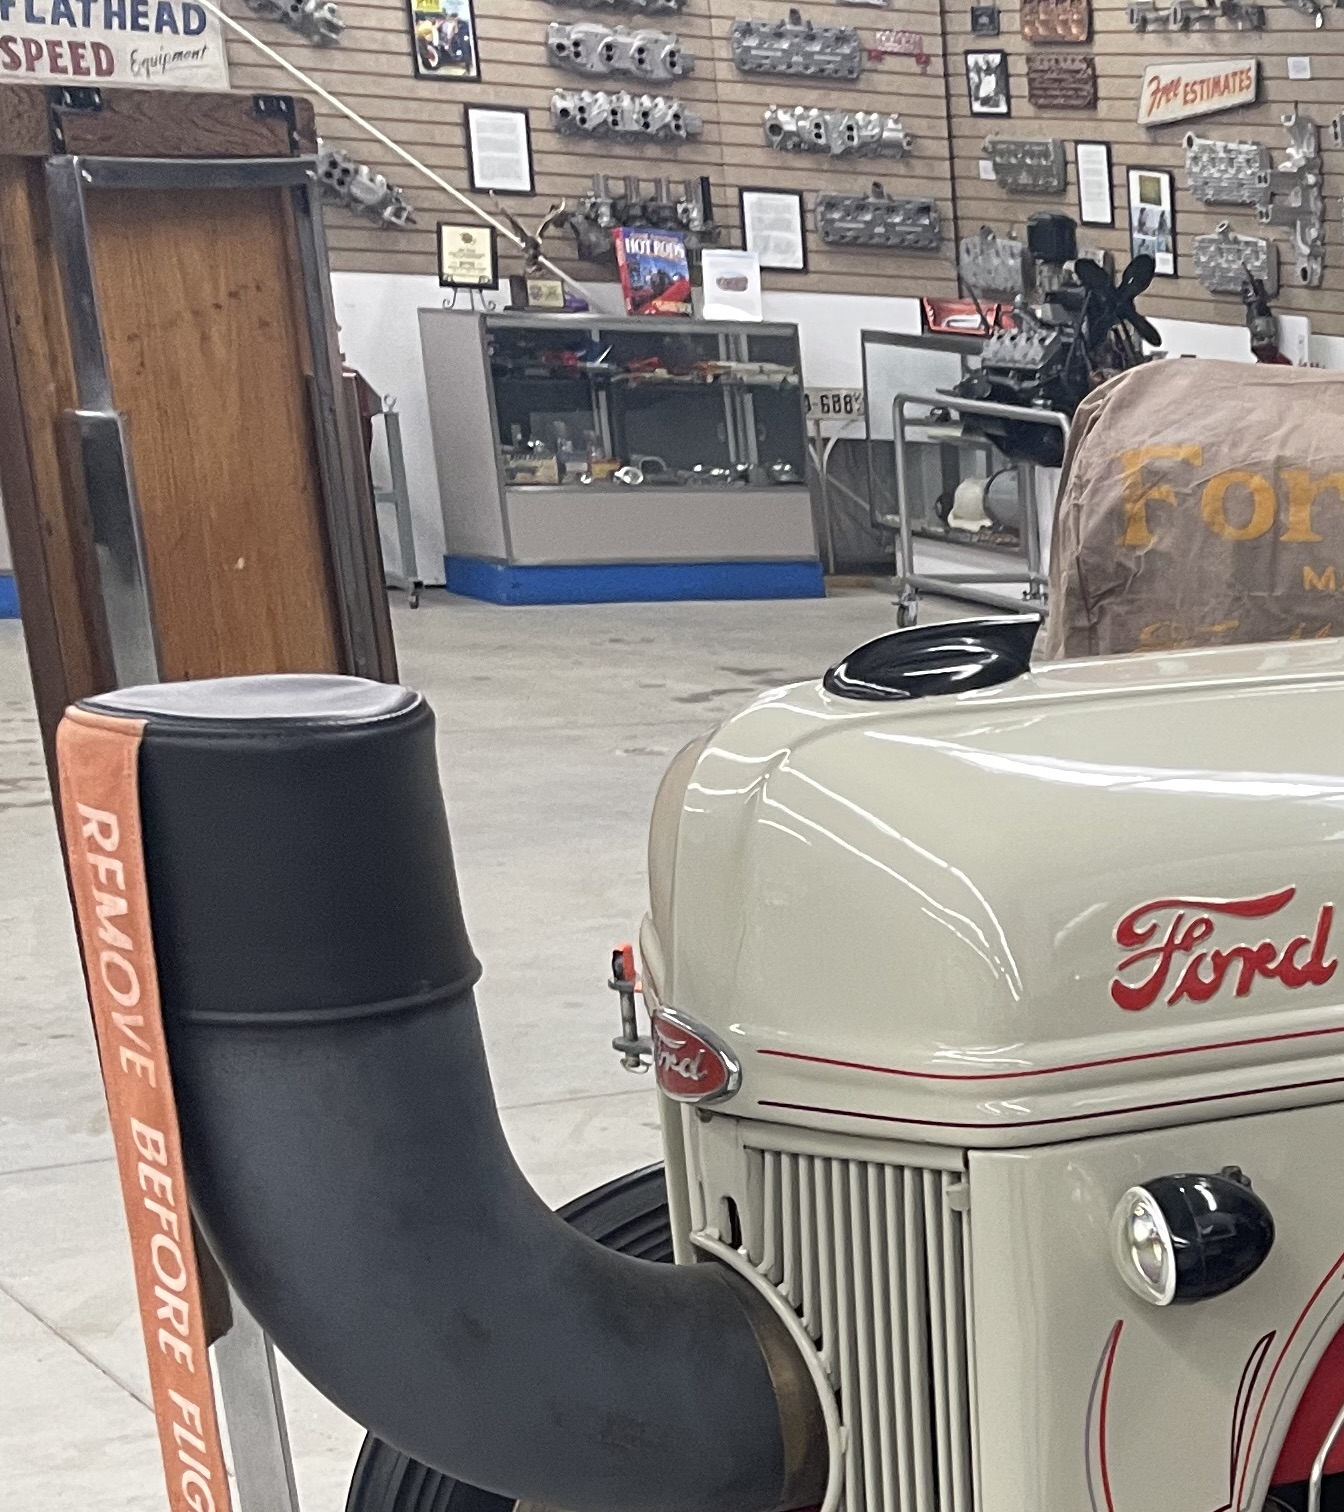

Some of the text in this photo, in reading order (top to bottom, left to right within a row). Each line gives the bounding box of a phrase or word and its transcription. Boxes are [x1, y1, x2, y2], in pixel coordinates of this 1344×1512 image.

[0, 0, 207, 36] FLATHEAD
[0, 34, 207, 78] SPEED Equipment
[1146, 65, 1252, 117] Free ESTIMATES
[1110, 884, 1338, 1011] Ford
[130, 1117, 194, 1374] BEFORE
